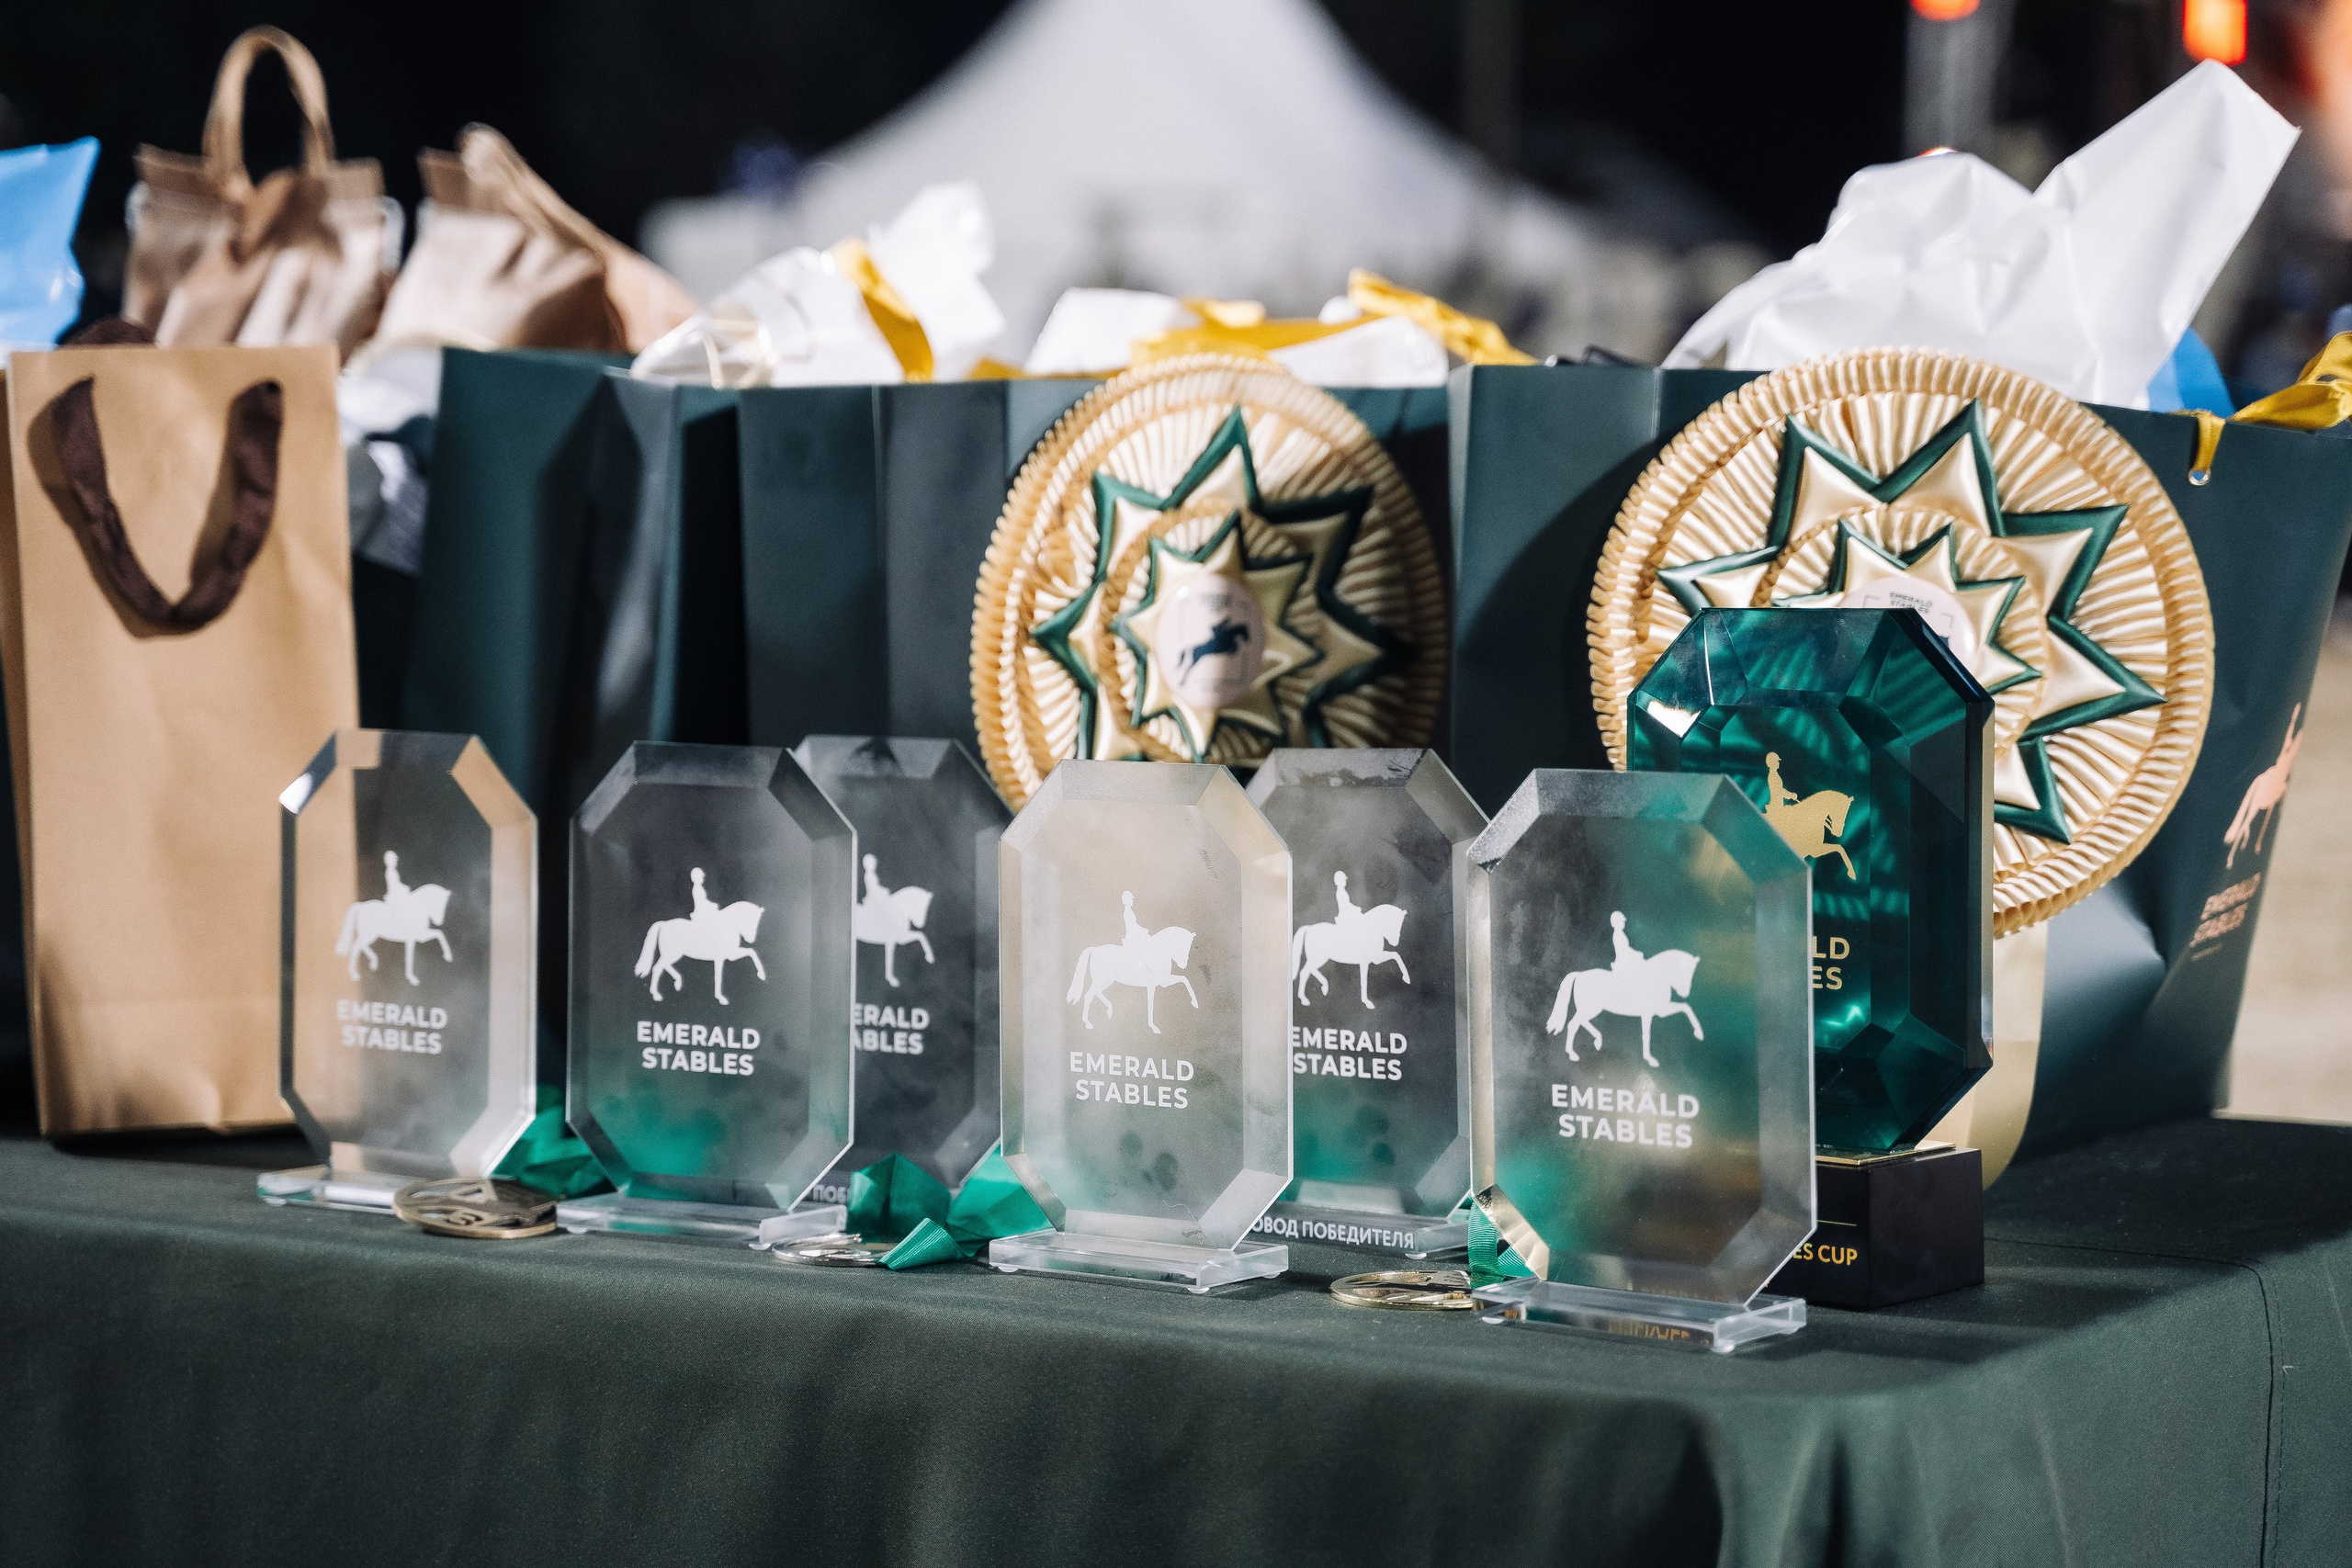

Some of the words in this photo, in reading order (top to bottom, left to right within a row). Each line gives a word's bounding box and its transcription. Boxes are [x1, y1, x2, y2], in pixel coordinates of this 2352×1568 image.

[336, 998, 448, 1029] EMERALD
[343, 1024, 442, 1055] STABLES
[637, 1021, 761, 1050] EMERALD
[1292, 1026, 1408, 1055] EMERALD
[642, 1047, 754, 1076] STABLES
[1069, 1051, 1194, 1081] EMERALD
[1293, 1052, 1403, 1081] STABLES
[1075, 1078, 1189, 1109] STABLES
[1551, 1083, 1700, 1120] EMERALD
[1558, 1113, 1693, 1148] STABLES
[1302, 1220, 1415, 1249] ПОБЕДИТЕЛЯ
[1817, 1245, 1858, 1266] CUP
